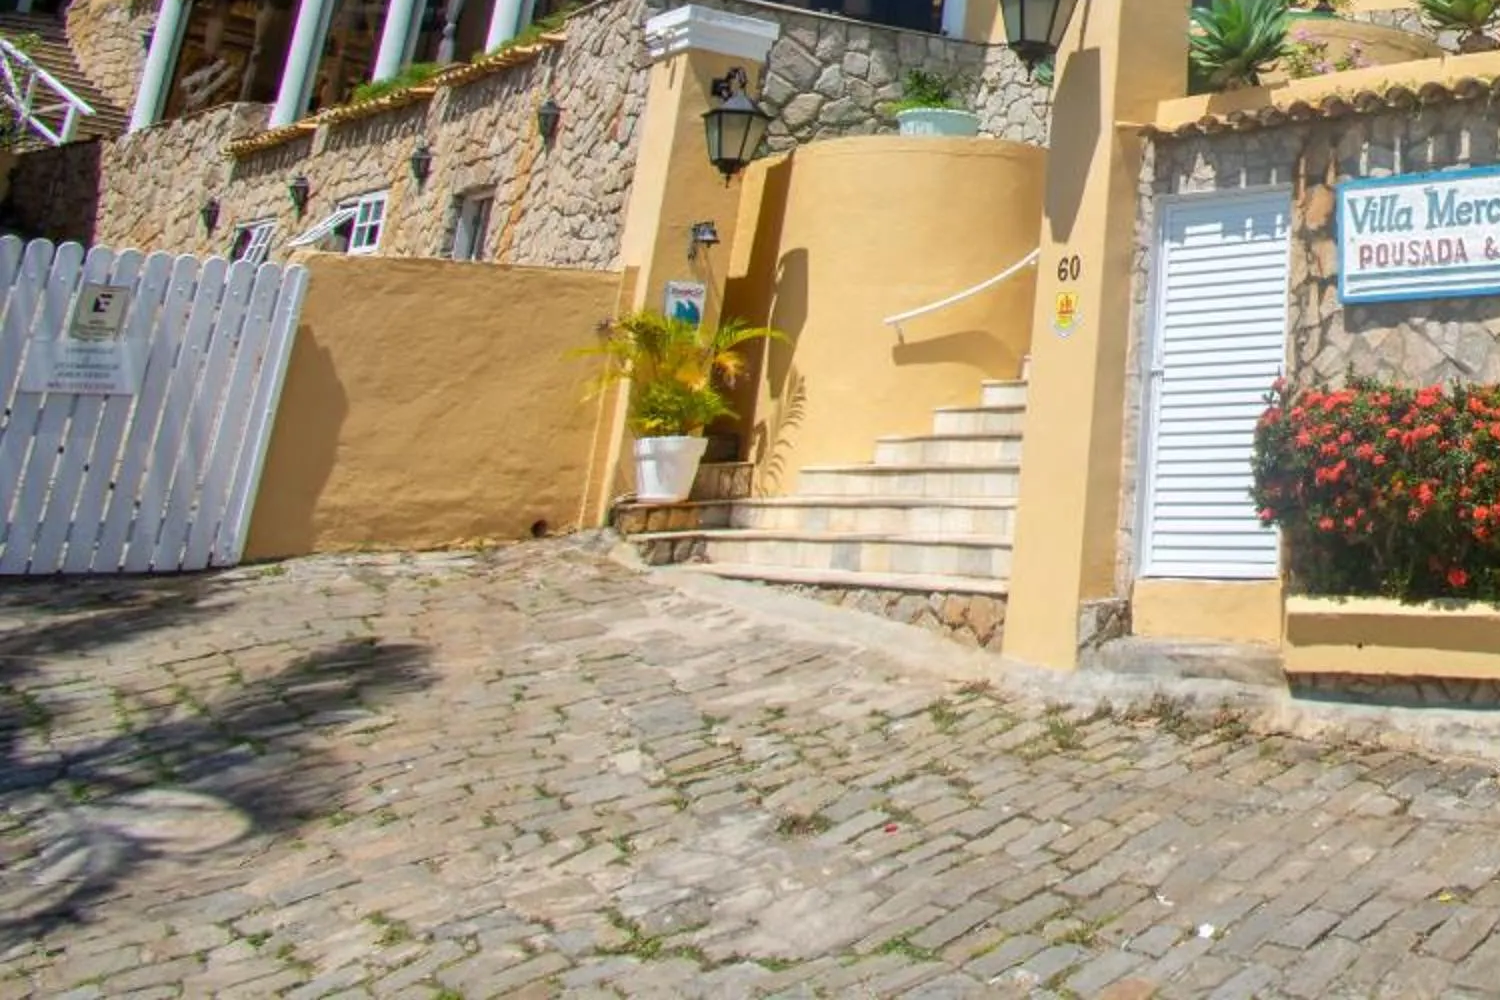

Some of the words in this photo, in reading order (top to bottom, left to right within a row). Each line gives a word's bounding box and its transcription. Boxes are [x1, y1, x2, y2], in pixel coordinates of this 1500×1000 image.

[1348, 193, 1413, 235] Villa
[1057, 255, 1081, 281] 60
[1359, 237, 1469, 270] POUSADA
